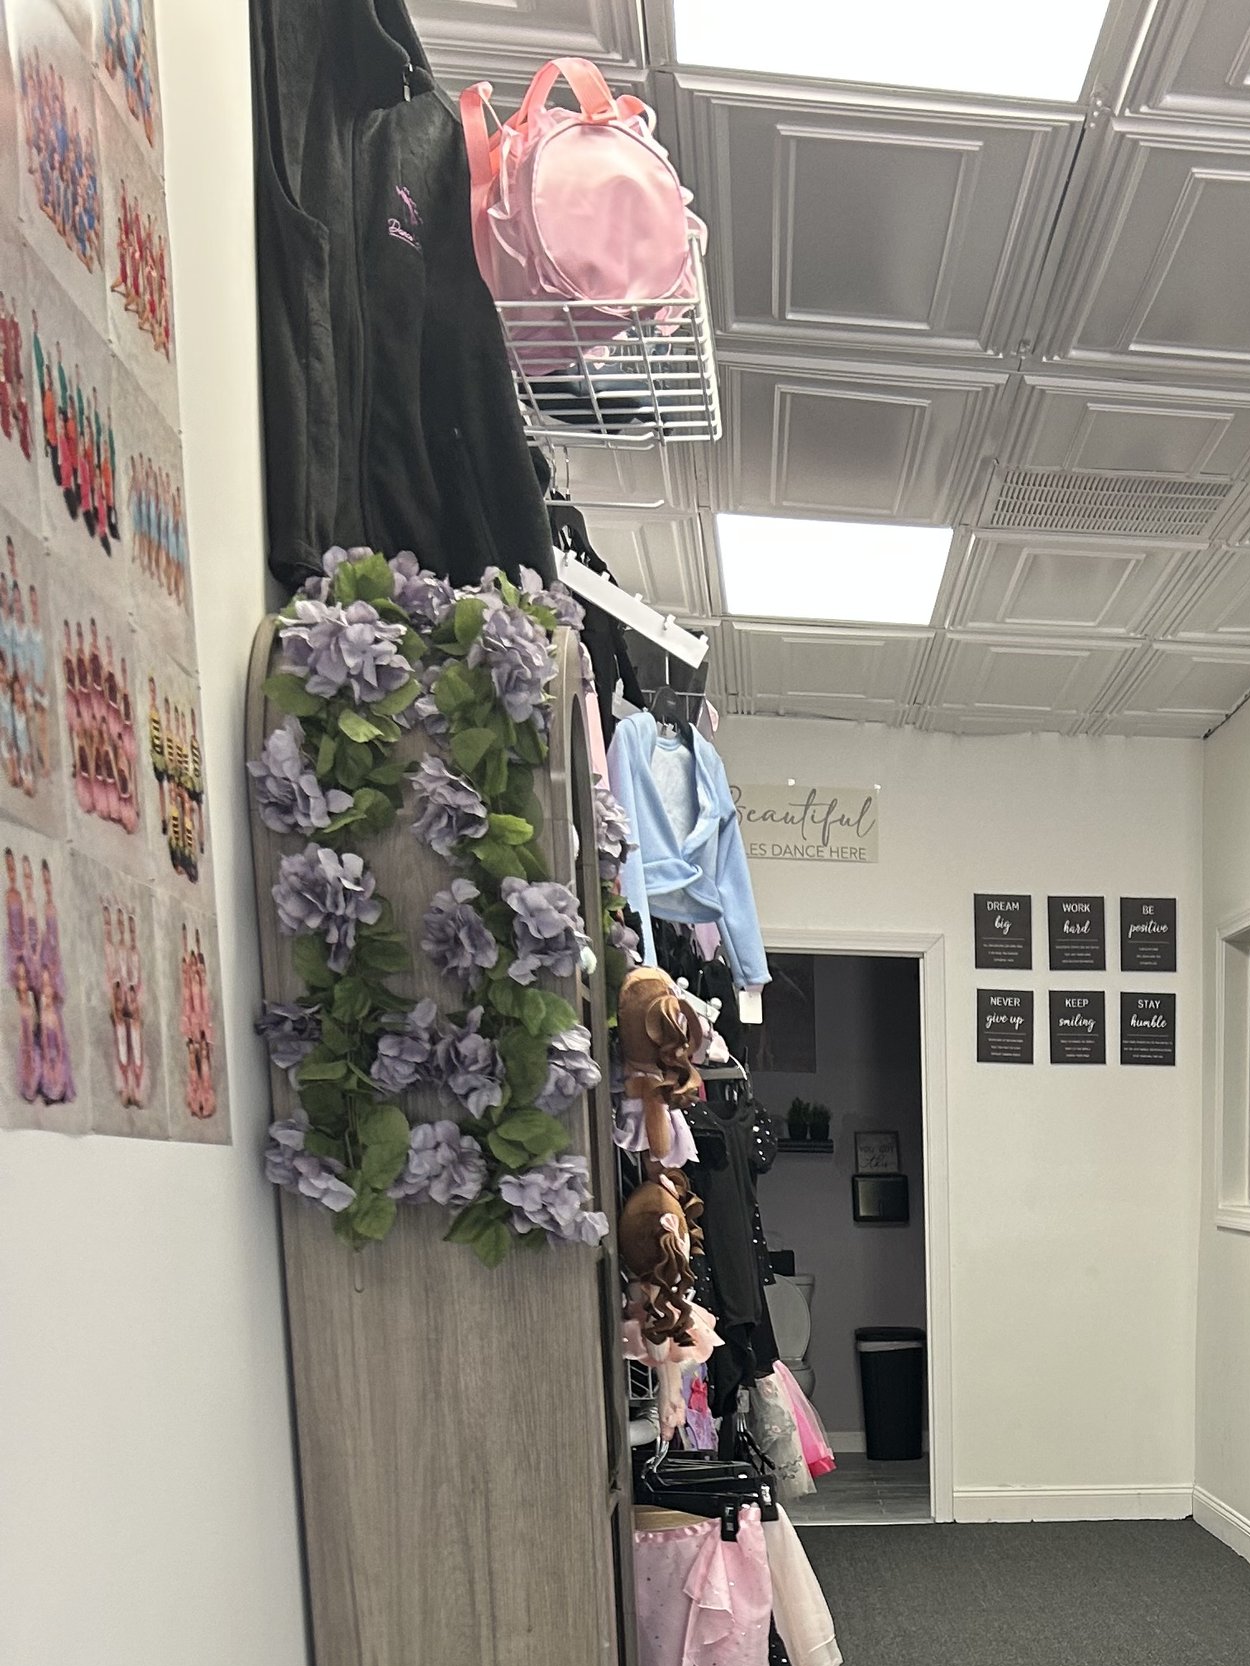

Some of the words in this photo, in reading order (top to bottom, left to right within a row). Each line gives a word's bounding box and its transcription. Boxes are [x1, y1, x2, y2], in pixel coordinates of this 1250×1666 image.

[771, 843, 825, 859] DANCE
[829, 846, 867, 861] HERE
[986, 901, 1020, 911] DREAM
[1062, 902, 1091, 913] WORK
[1142, 904, 1155, 915] BE
[994, 915, 1012, 935] big
[1063, 919, 1091, 934] hard
[1127, 919, 1169, 938] positive
[989, 996, 1020, 1007] NEVER
[1065, 998, 1089, 1008] KEEP
[1137, 999, 1161, 1009] STAY
[985, 1012, 1008, 1029] give
[1009, 1014, 1024, 1030] up
[1059, 1013, 1096, 1033] smiling
[1130, 1013, 1167, 1028] humble
